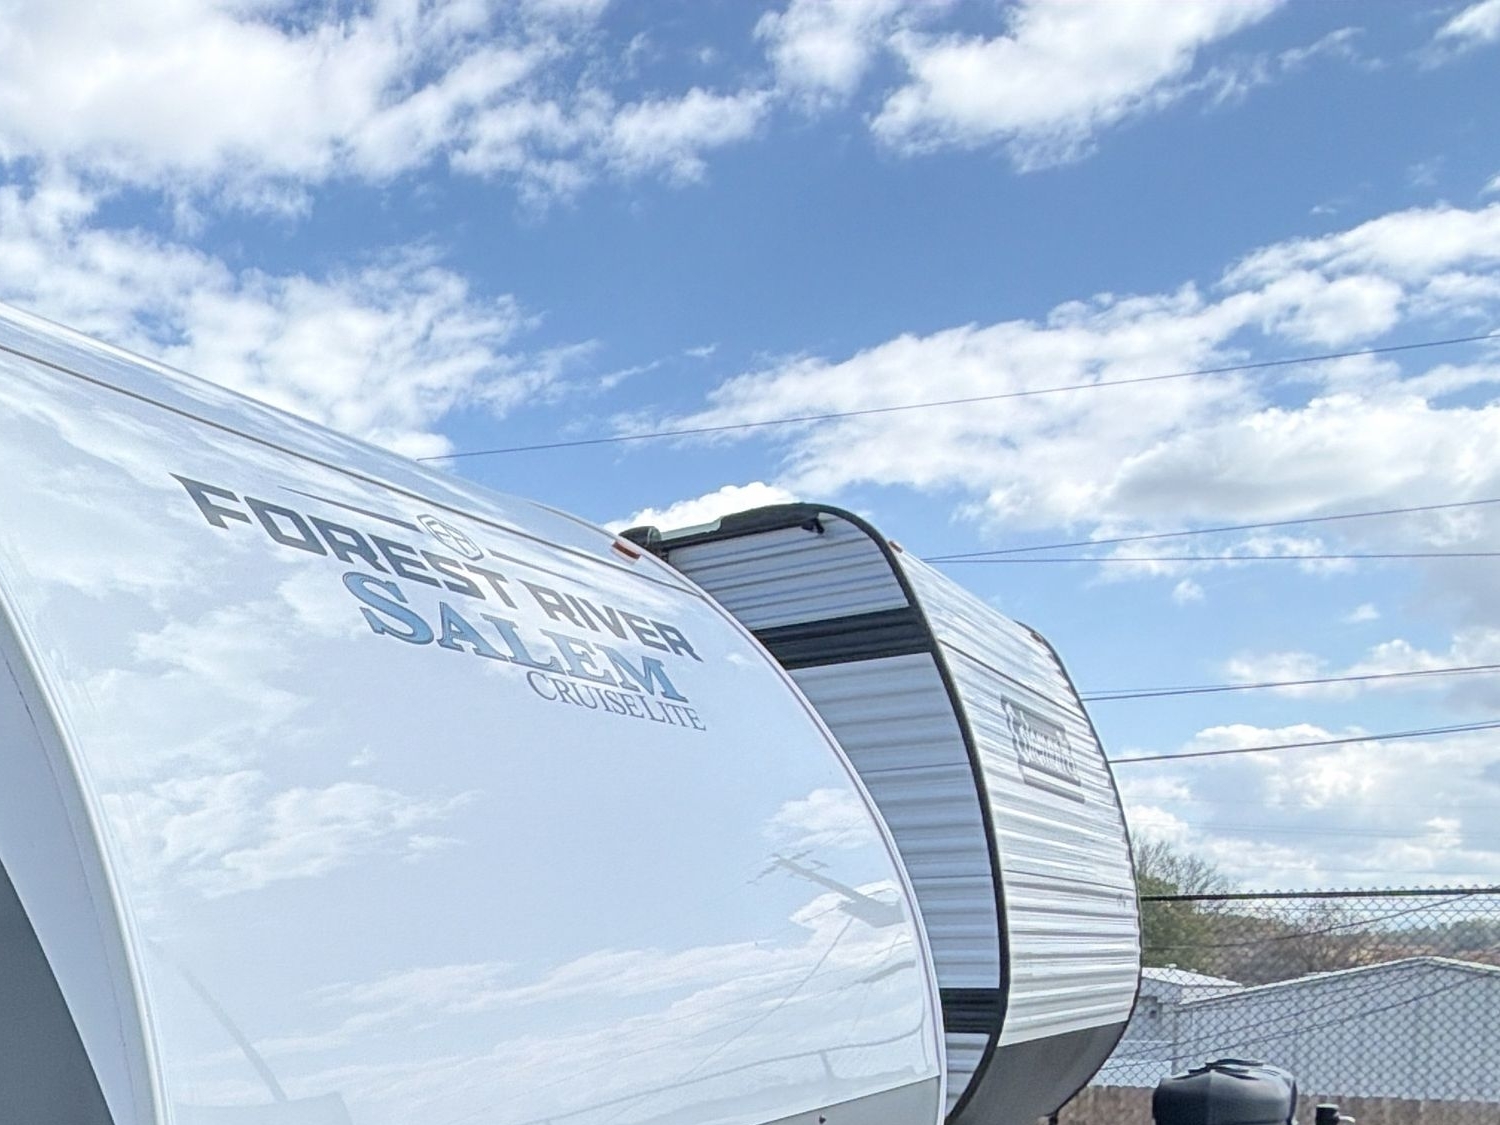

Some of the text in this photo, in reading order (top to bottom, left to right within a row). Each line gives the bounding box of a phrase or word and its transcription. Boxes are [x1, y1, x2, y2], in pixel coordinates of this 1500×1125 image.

[169, 472, 704, 663] FOREST RIVER
[342, 571, 689, 704] SALEM
[526, 670, 707, 731] CRUISELITE
